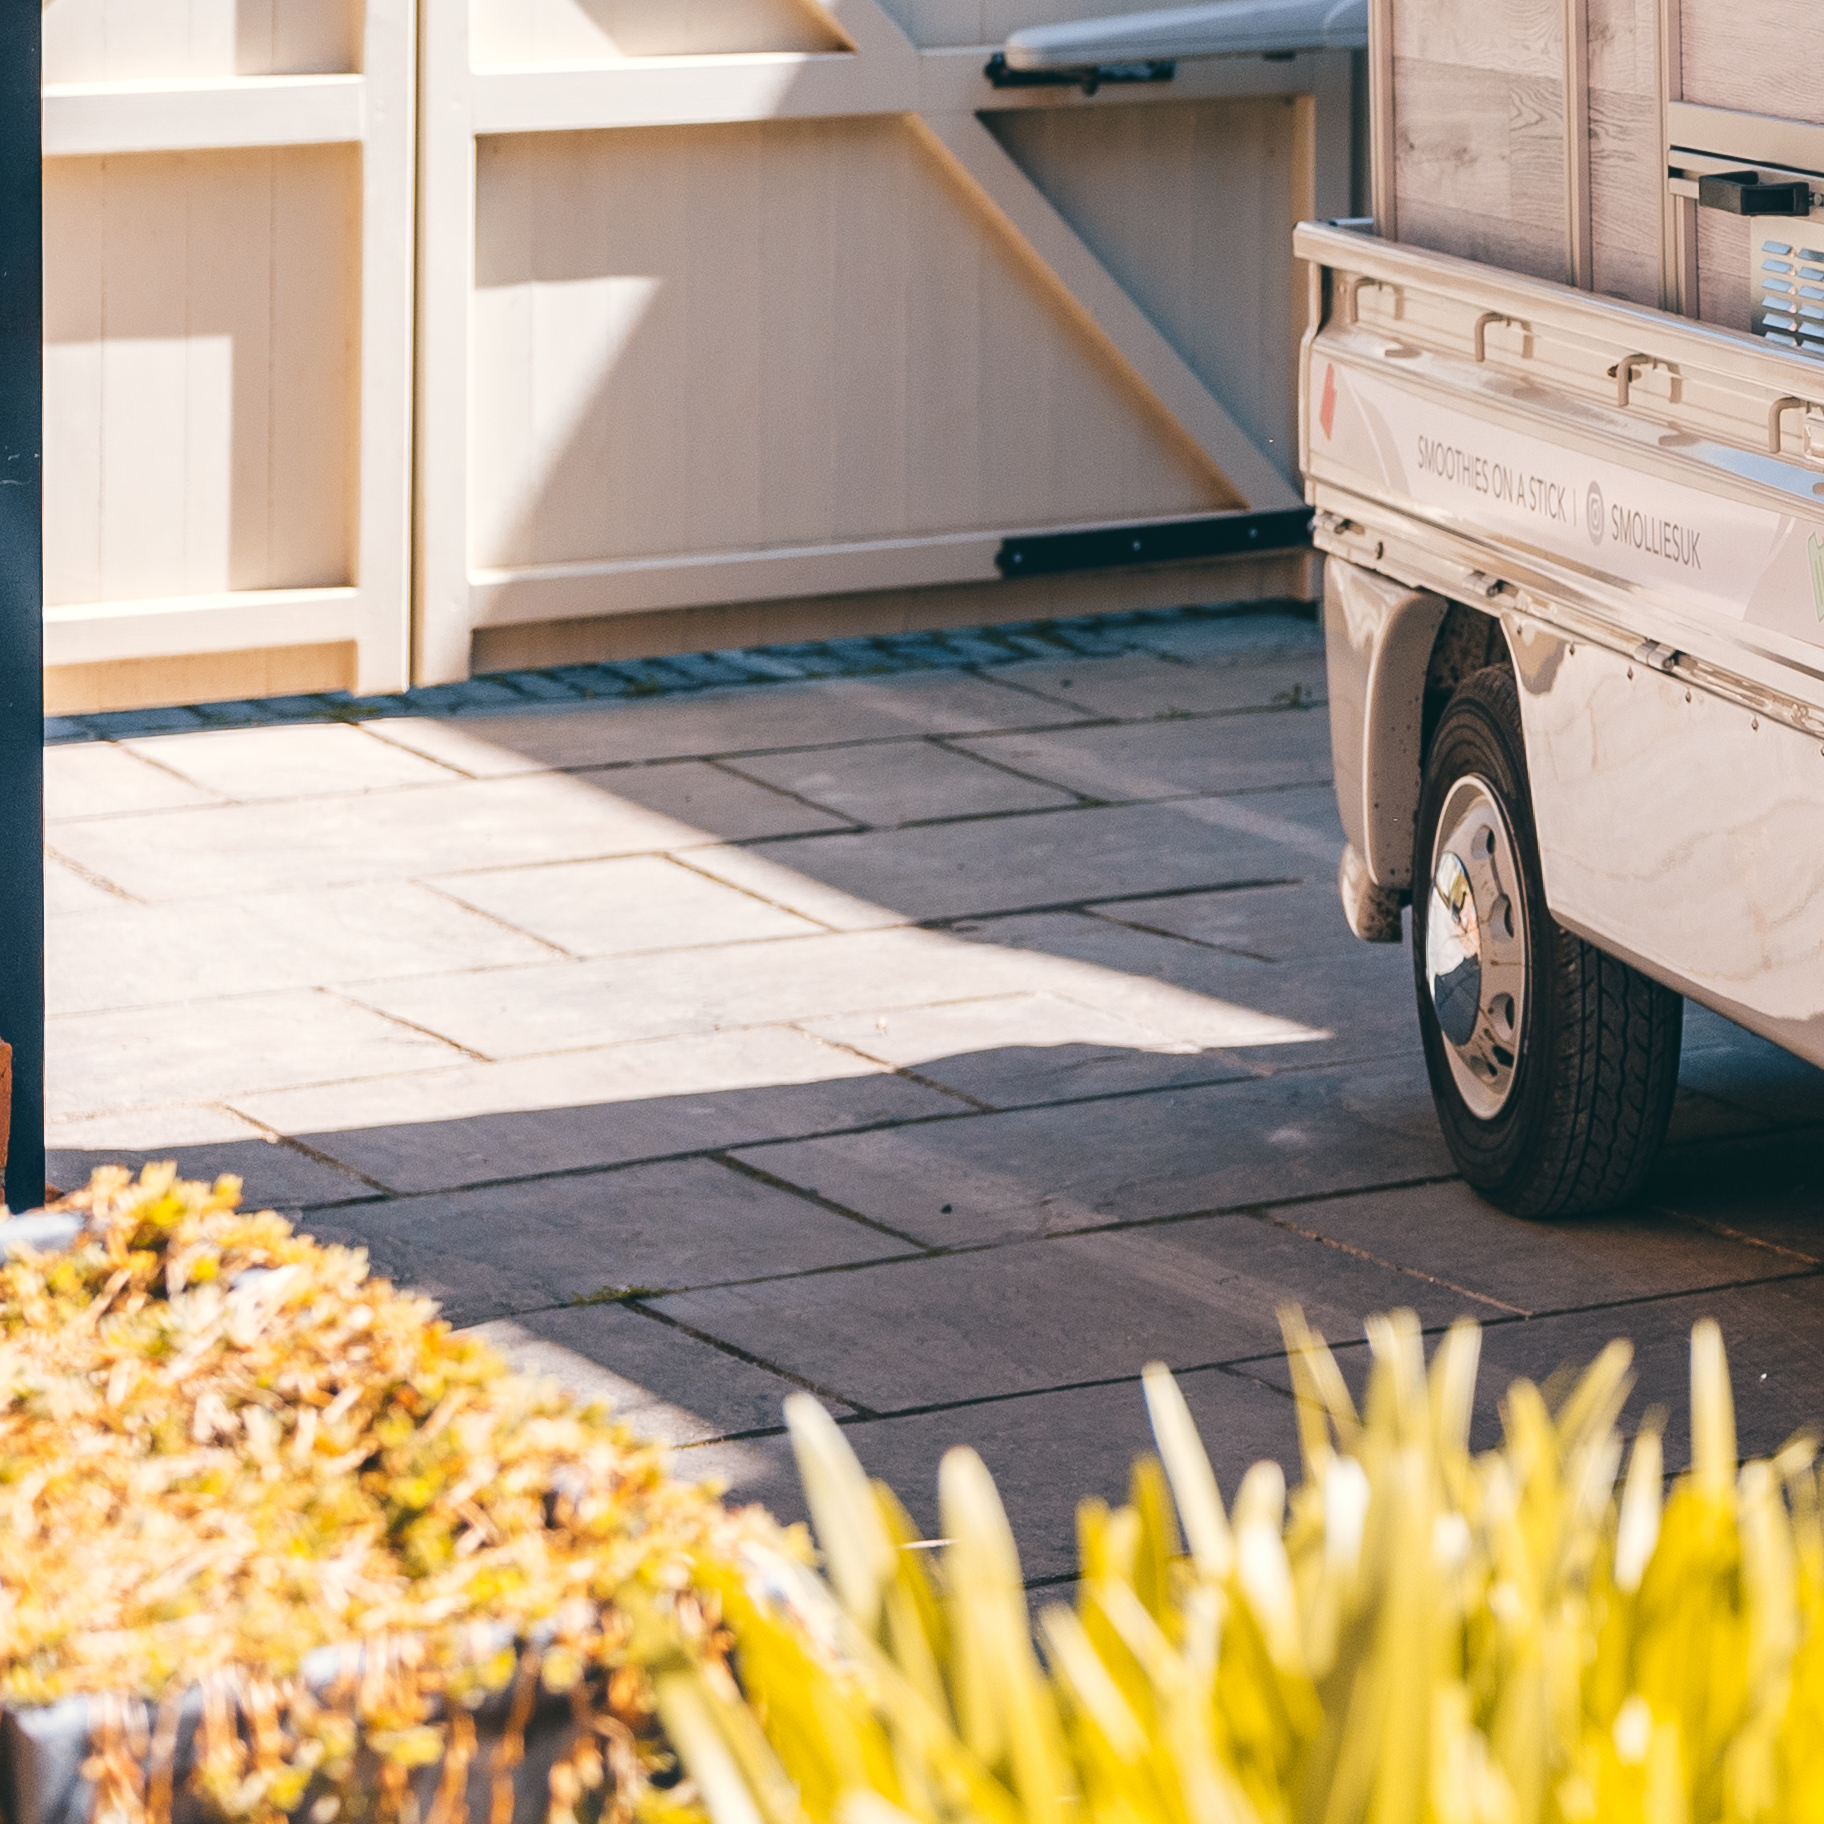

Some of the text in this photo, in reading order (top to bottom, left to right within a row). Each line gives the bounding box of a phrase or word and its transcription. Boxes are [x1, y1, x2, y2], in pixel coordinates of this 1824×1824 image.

[1418, 434, 1567, 524] SMOOTHIES ON A STICK
[1611, 503, 1702, 571] SMOLLIESUK
